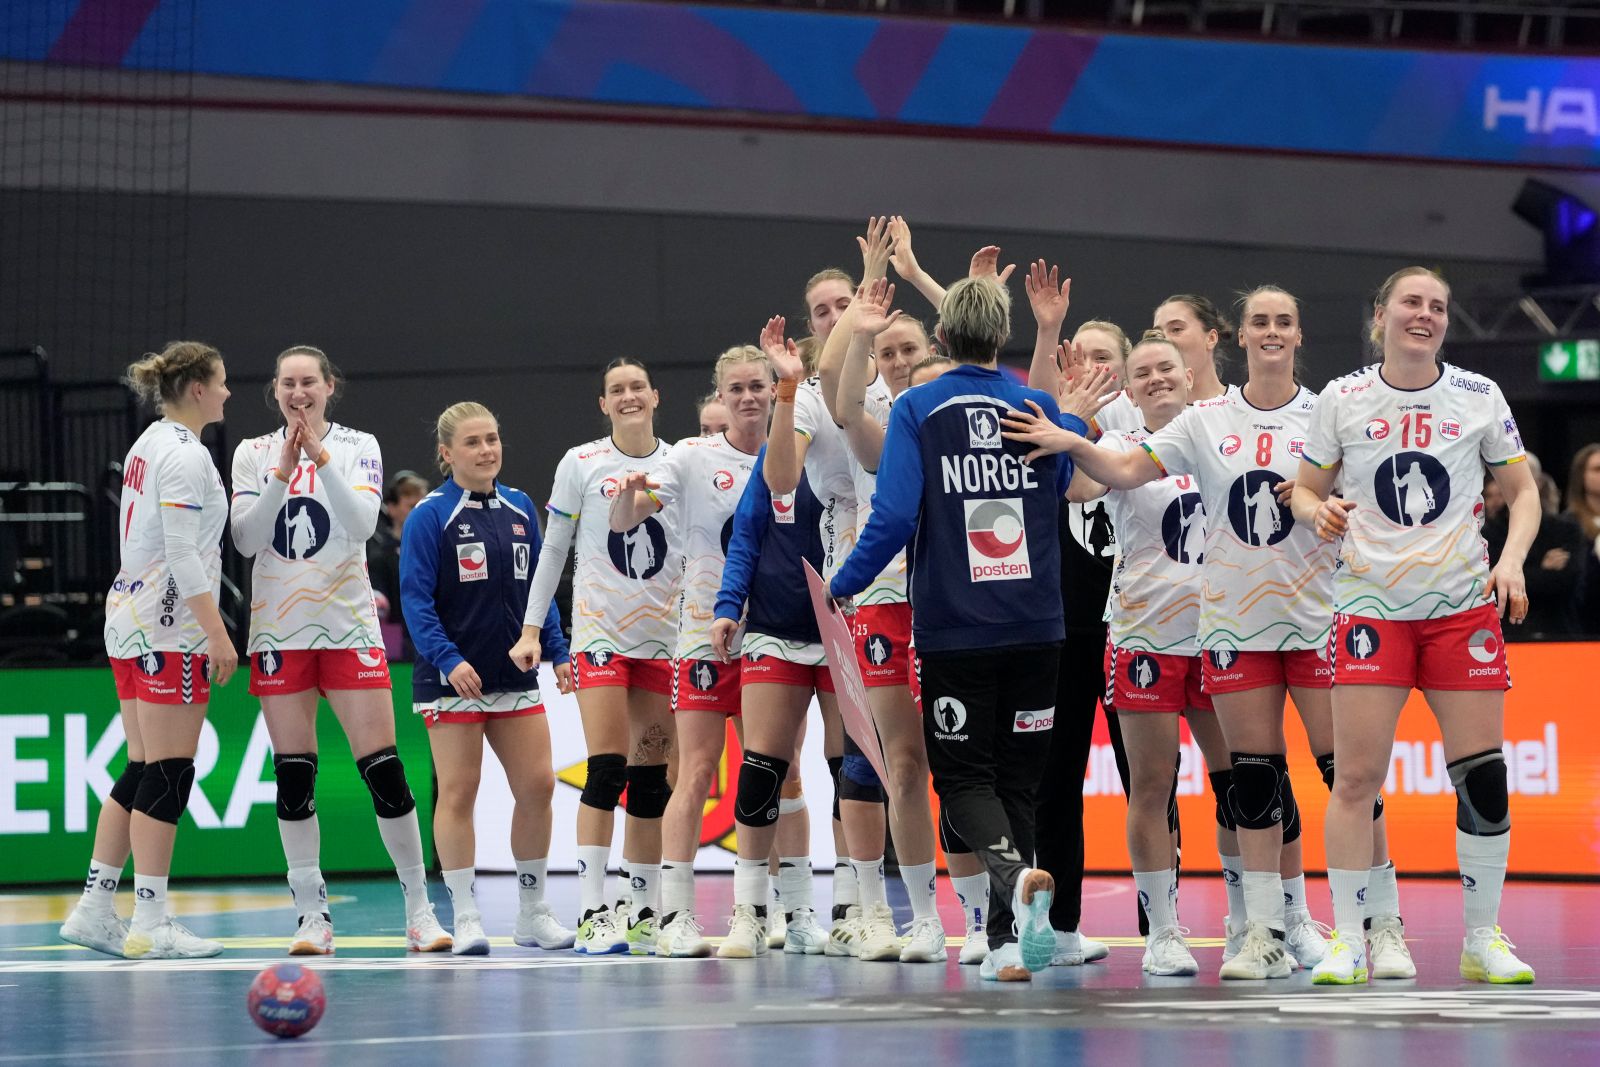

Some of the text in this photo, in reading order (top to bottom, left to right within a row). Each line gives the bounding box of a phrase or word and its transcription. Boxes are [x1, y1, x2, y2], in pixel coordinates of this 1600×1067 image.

[1450, 375, 1491, 395] GJENSIDIGE
[1400, 412, 1433, 449] 15
[1256, 432, 1273, 467] 8
[289, 463, 316, 495] 21
[941, 453, 1039, 494] NORGE
[460, 571, 487, 581] posten
[973, 562, 1028, 581] posten
[1339, 614, 1350, 625] 15
[857, 624, 868, 636] 25
[1345, 663, 1380, 671] Gjensidige
[1469, 667, 1501, 678] posten
[358, 670, 385, 680] posten
[1125, 691, 1160, 701] Gjensidige
[934, 731, 969, 742] Gjensidige
